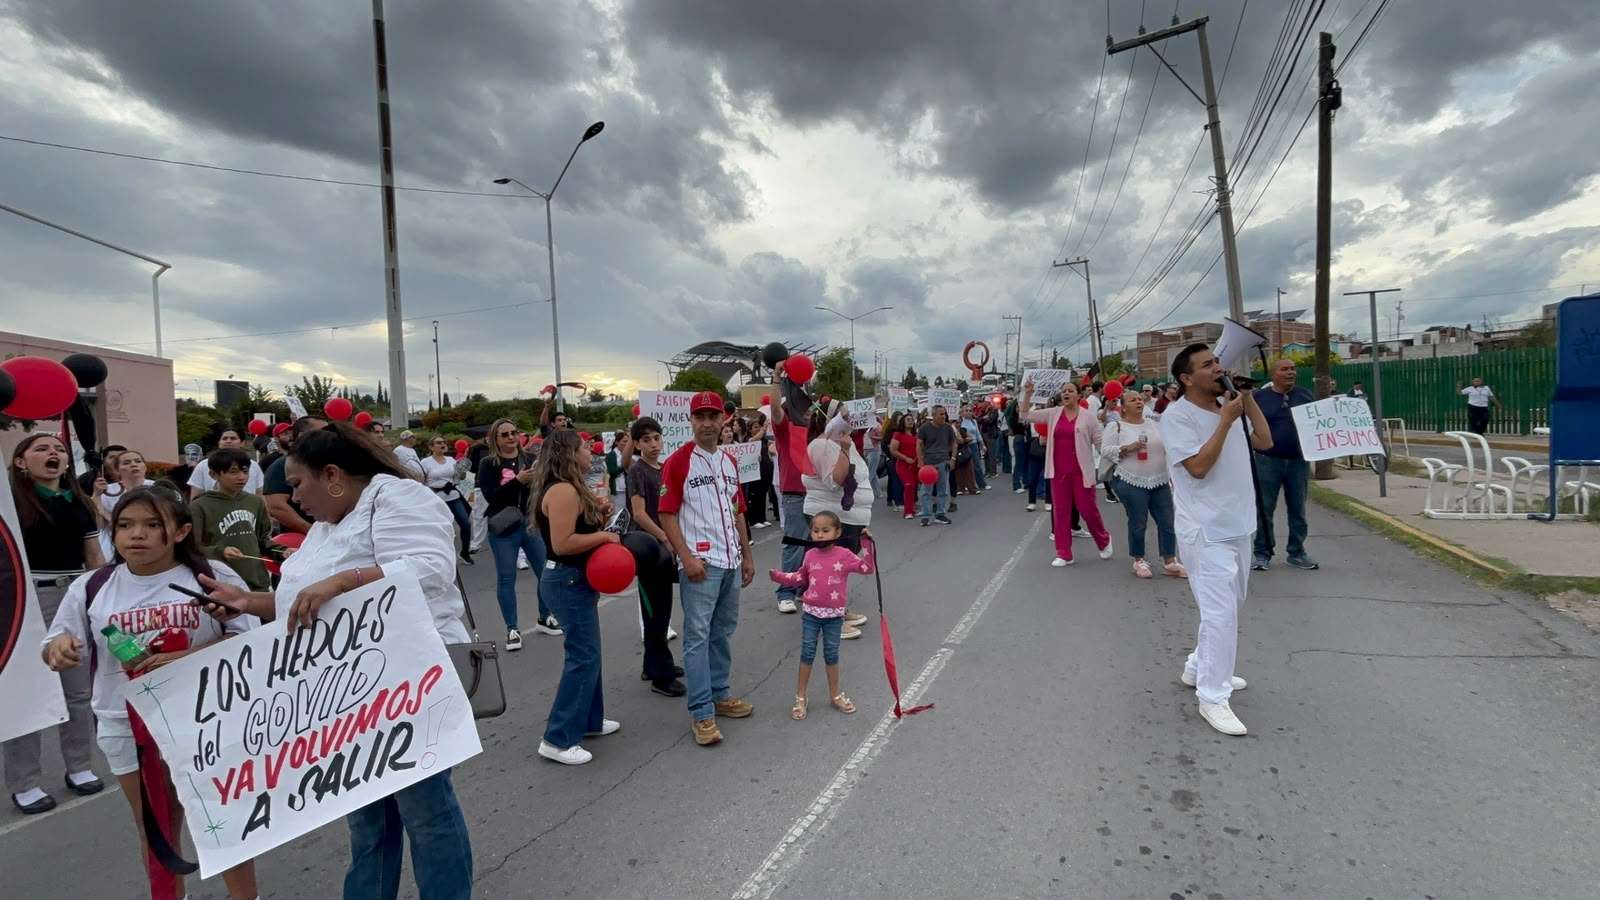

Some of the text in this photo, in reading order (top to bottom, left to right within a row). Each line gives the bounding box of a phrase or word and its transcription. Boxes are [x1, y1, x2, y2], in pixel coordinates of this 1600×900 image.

[655, 394, 691, 407] EXIGIM
[1305, 405, 1322, 419] EL
[668, 412, 691, 423] NUEV
[1315, 415, 1374, 431] NO TIENE
[661, 425, 694, 437] OSPIT
[108, 602, 201, 636] CHERRIES
[194, 584, 397, 724] LOS HEROES
[193, 648, 387, 772] del COVID
[212, 664, 444, 806] YA VOLVIMOS
[241, 791, 271, 841] A
